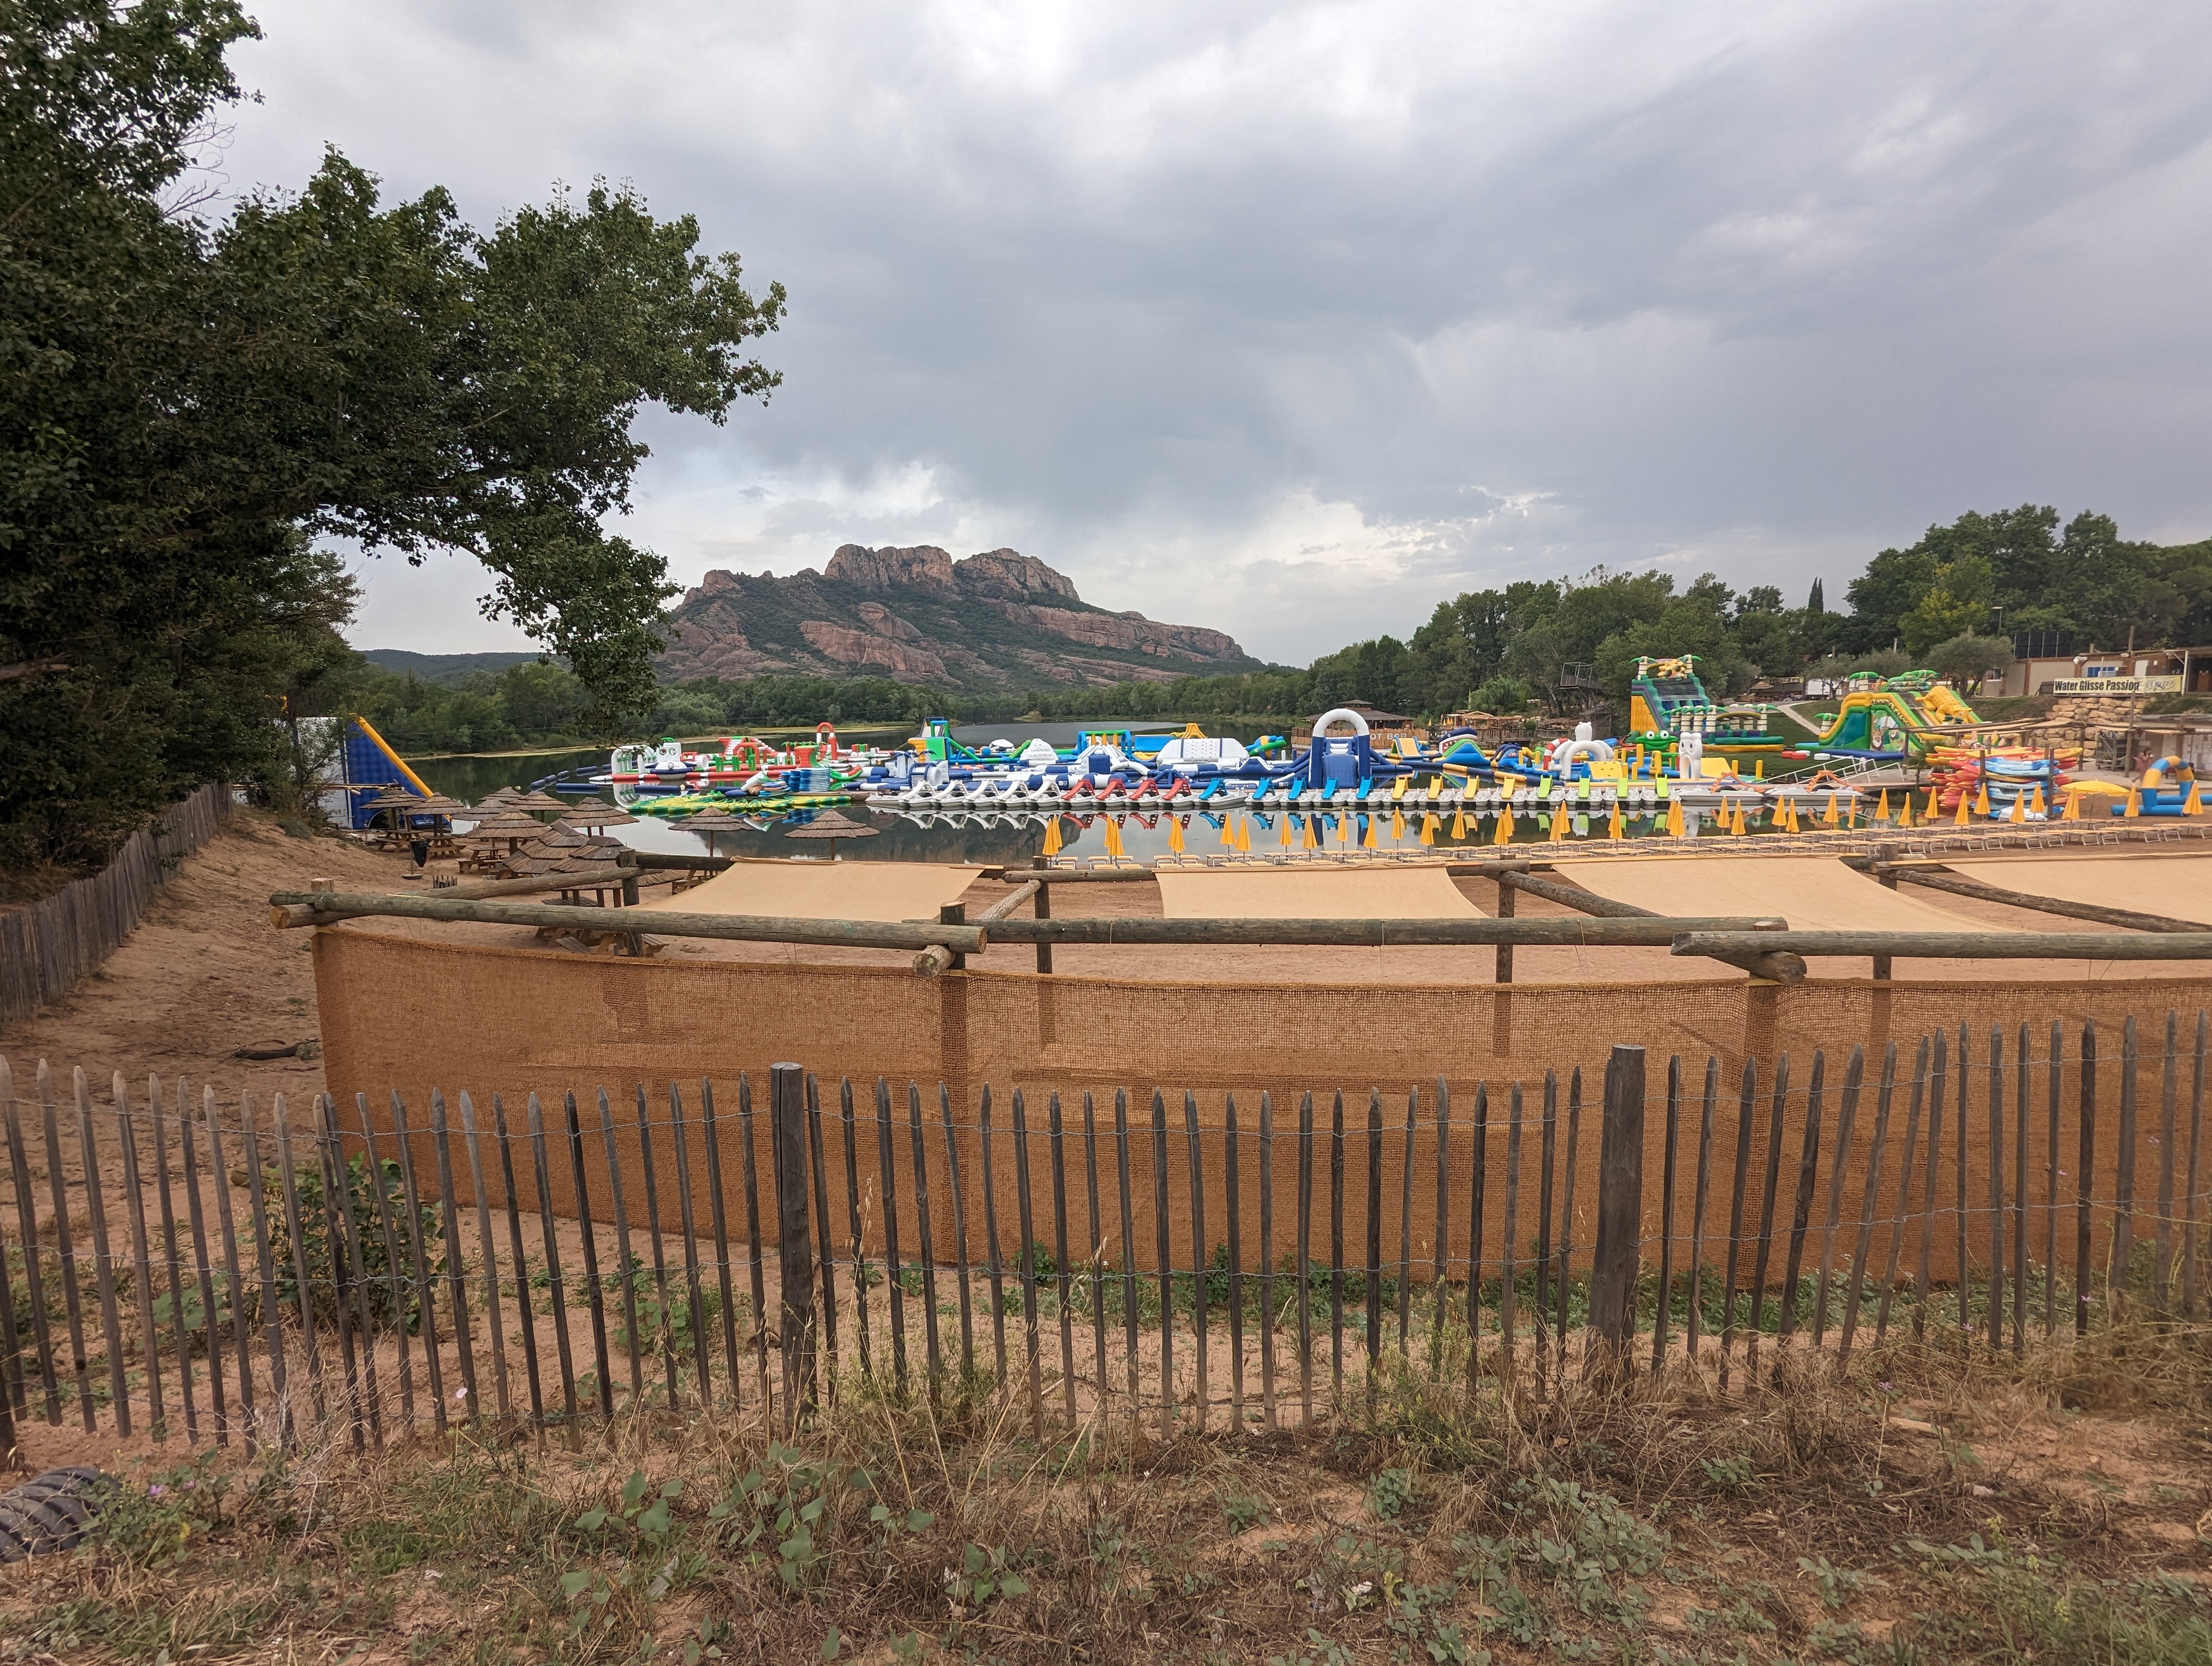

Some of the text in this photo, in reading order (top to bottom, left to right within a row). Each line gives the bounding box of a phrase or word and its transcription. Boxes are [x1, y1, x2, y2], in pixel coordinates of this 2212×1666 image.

[2055, 681, 2078, 691] Water
[2080, 680, 2104, 691] Glisse
[2106, 680, 2139, 691] Passion
